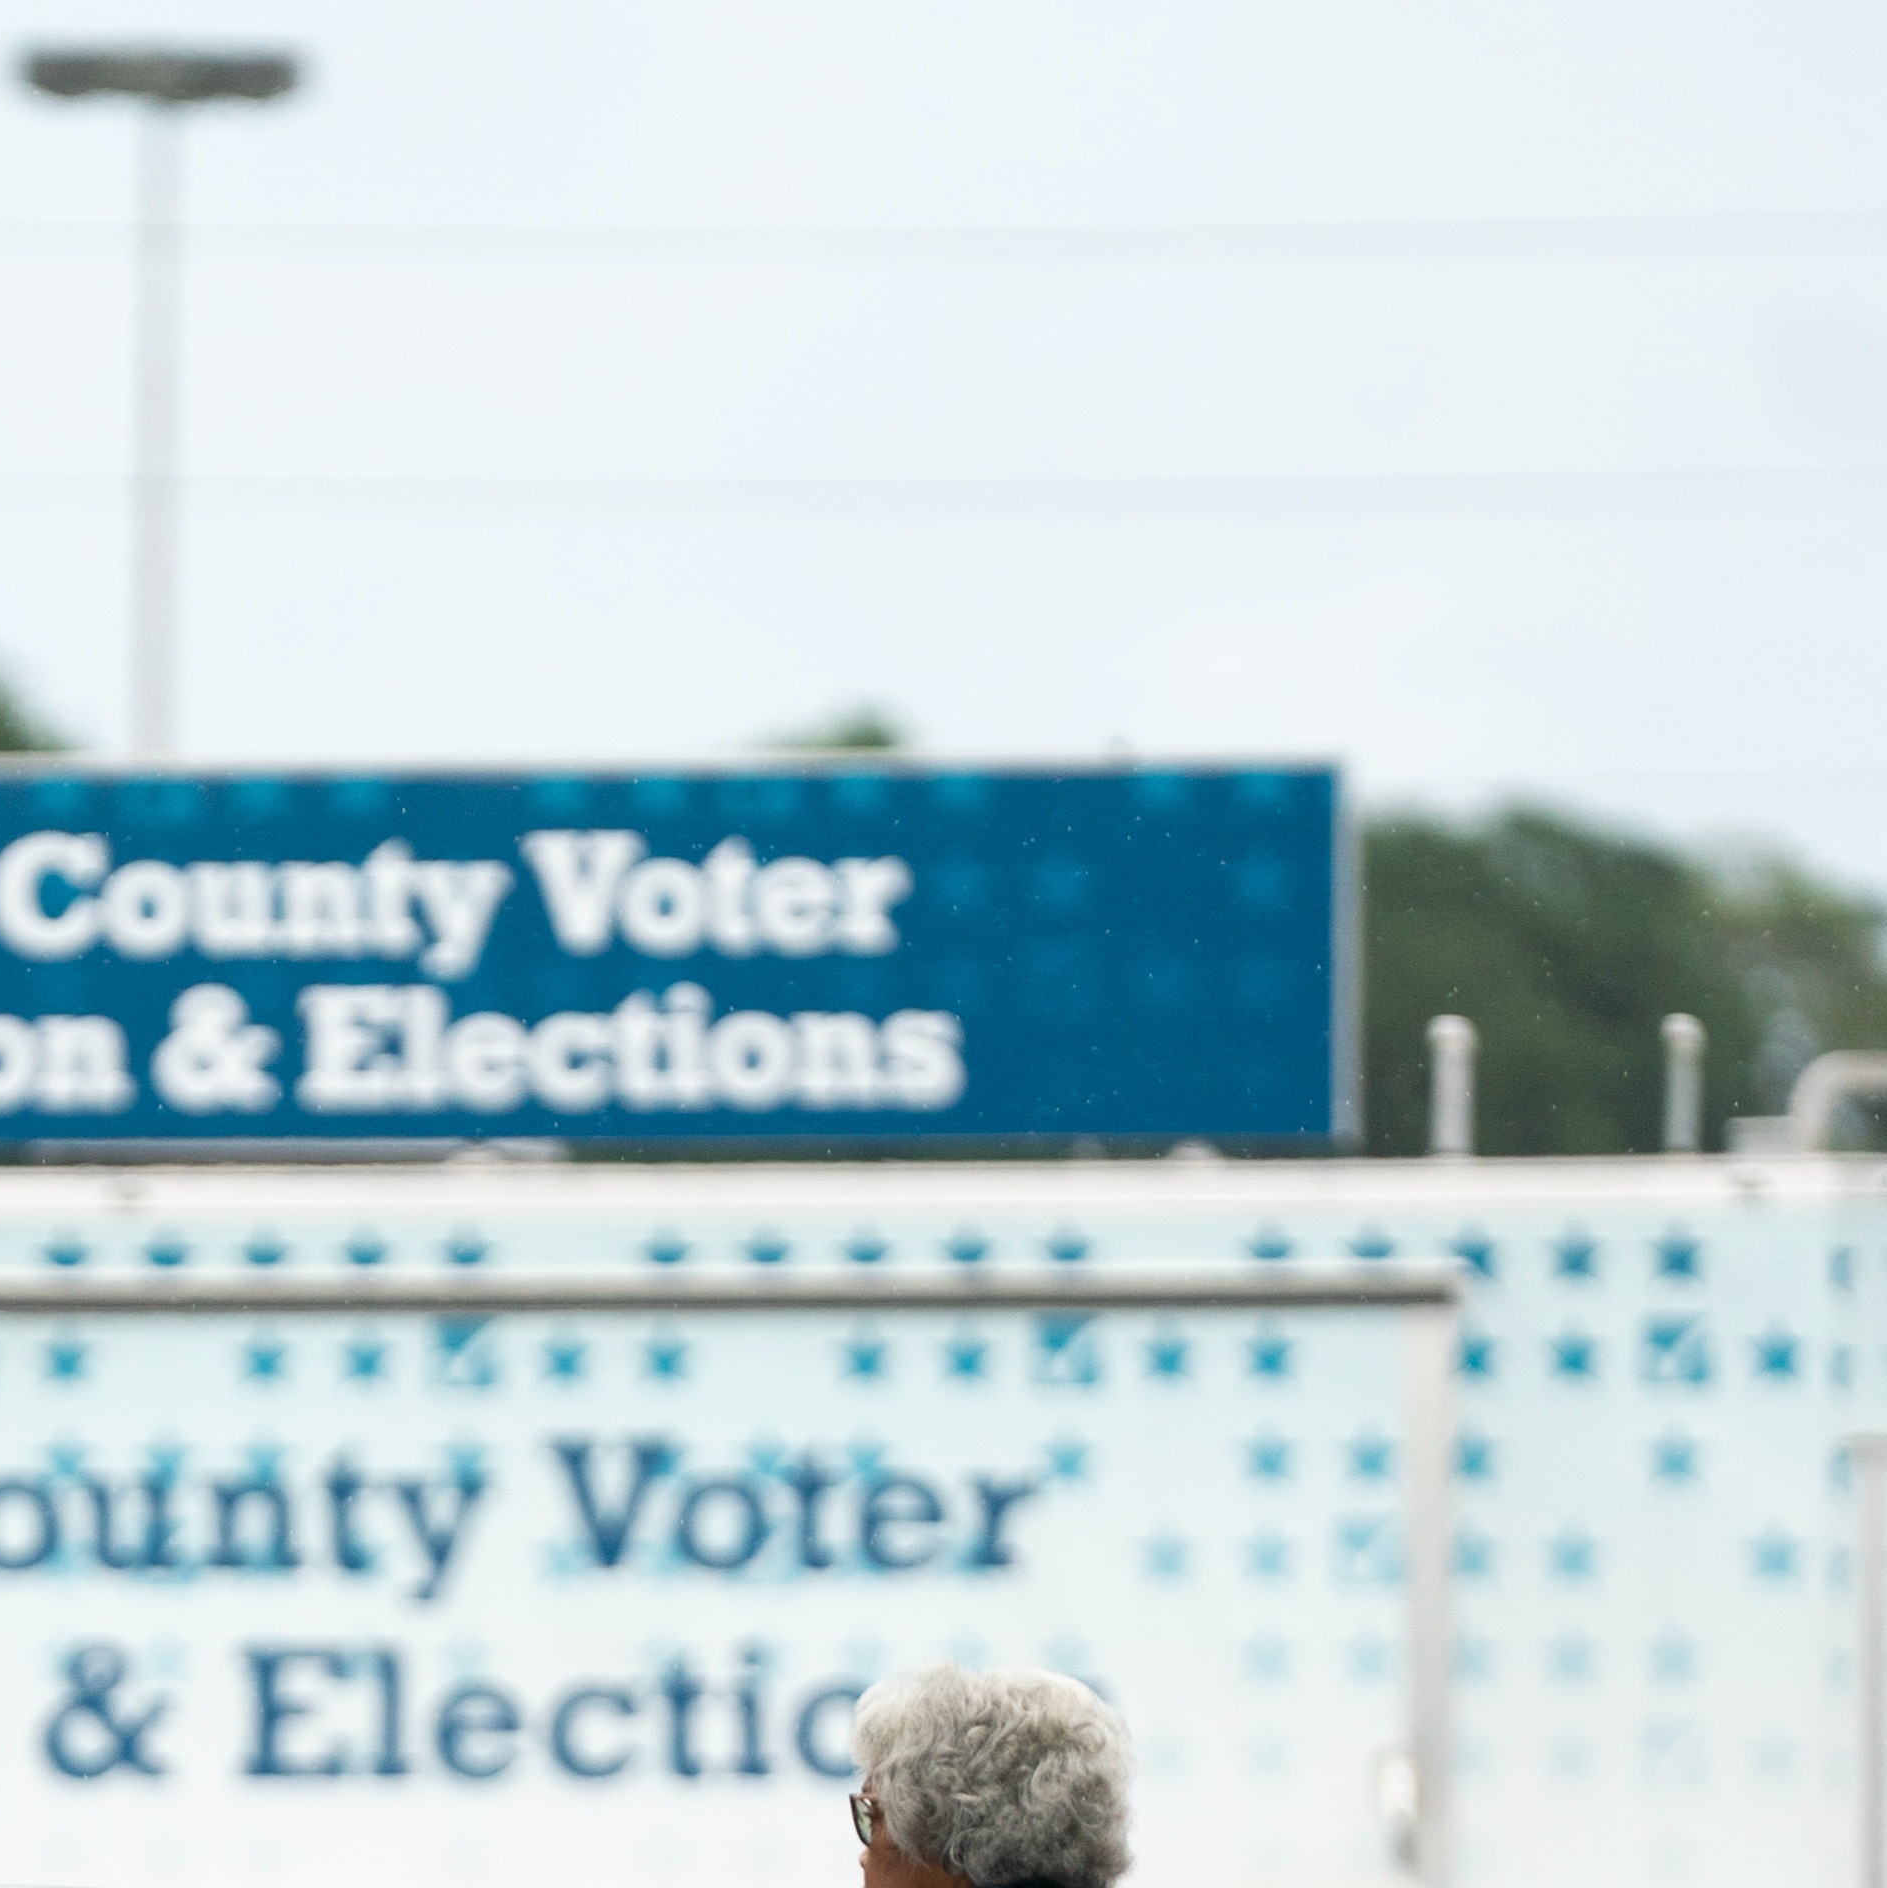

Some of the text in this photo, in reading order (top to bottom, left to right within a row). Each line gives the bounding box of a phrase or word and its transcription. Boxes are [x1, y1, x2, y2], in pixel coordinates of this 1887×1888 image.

[520, 828, 912, 957] Voter
[150, 983, 281, 1112] &
[295, 981, 965, 1112] Elections
[543, 1435, 1048, 1572] Voter
[39, 1641, 179, 1781] &
[243, 1640, 863, 1781] Electio
